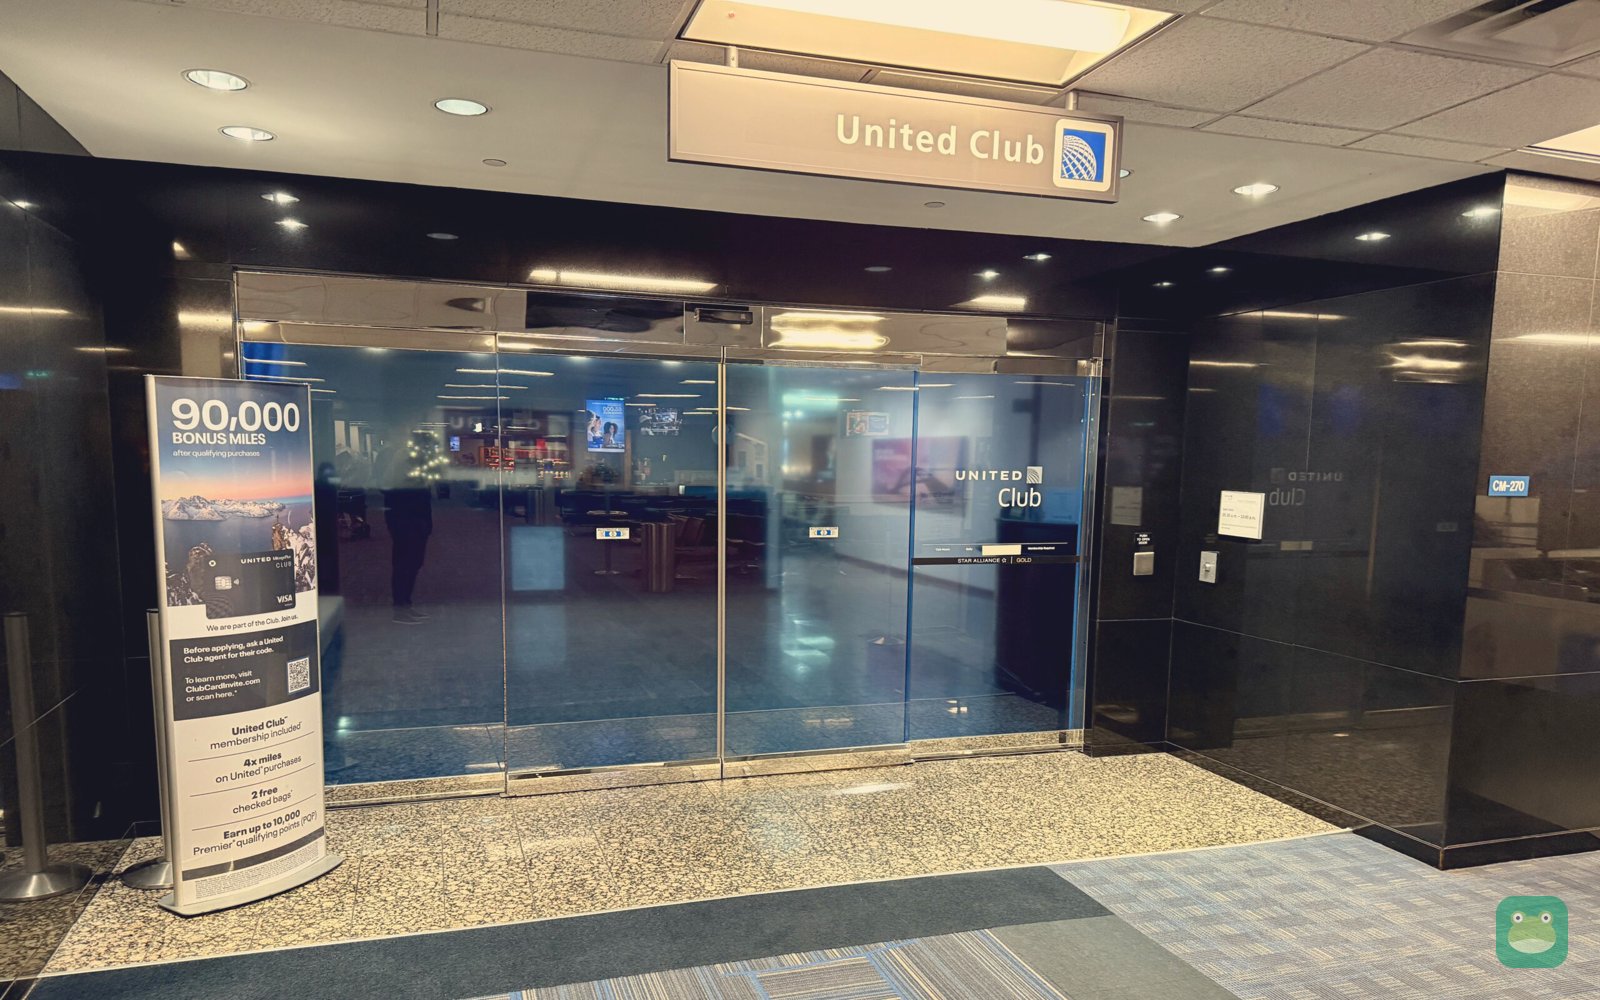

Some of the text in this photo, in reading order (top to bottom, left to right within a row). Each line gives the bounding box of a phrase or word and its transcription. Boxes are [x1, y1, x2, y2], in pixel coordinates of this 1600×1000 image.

[836, 114, 1044, 166] United Club
[172, 398, 300, 432] 90,000
[172, 432, 266, 445] BONUS MILES
[192, 450, 227, 458] qualifying
[228, 450, 260, 458] purchases
[955, 470, 1022, 480] UNITED
[1492, 480, 1525, 492] CM-270
[998, 488, 1042, 507] Club
[277, 594, 292, 603] VISA
[233, 622, 247, 631] part
[266, 617, 280, 625] Club.
[184, 646, 210, 654] Before
[211, 643, 245, 653] applying,
[264, 636, 284, 645] United
[204, 653, 227, 662] agent
[256, 647, 274, 655] code.
[238, 670, 252, 678] visit
[185, 678, 260, 693] ClubCardInvite.com
[232, 722, 264, 735] United
[210, 733, 269, 750] membership
[244, 752, 282, 767] 4x miles
[216, 775, 229, 783] on
[263, 756, 302, 774] purchases
[251, 786, 278, 799] 2 free
[233, 798, 272, 814] checked
[223, 810, 300, 839] Earn up to 10,000
[236, 829, 278, 848] qualifying
[279, 820, 300, 836] points
